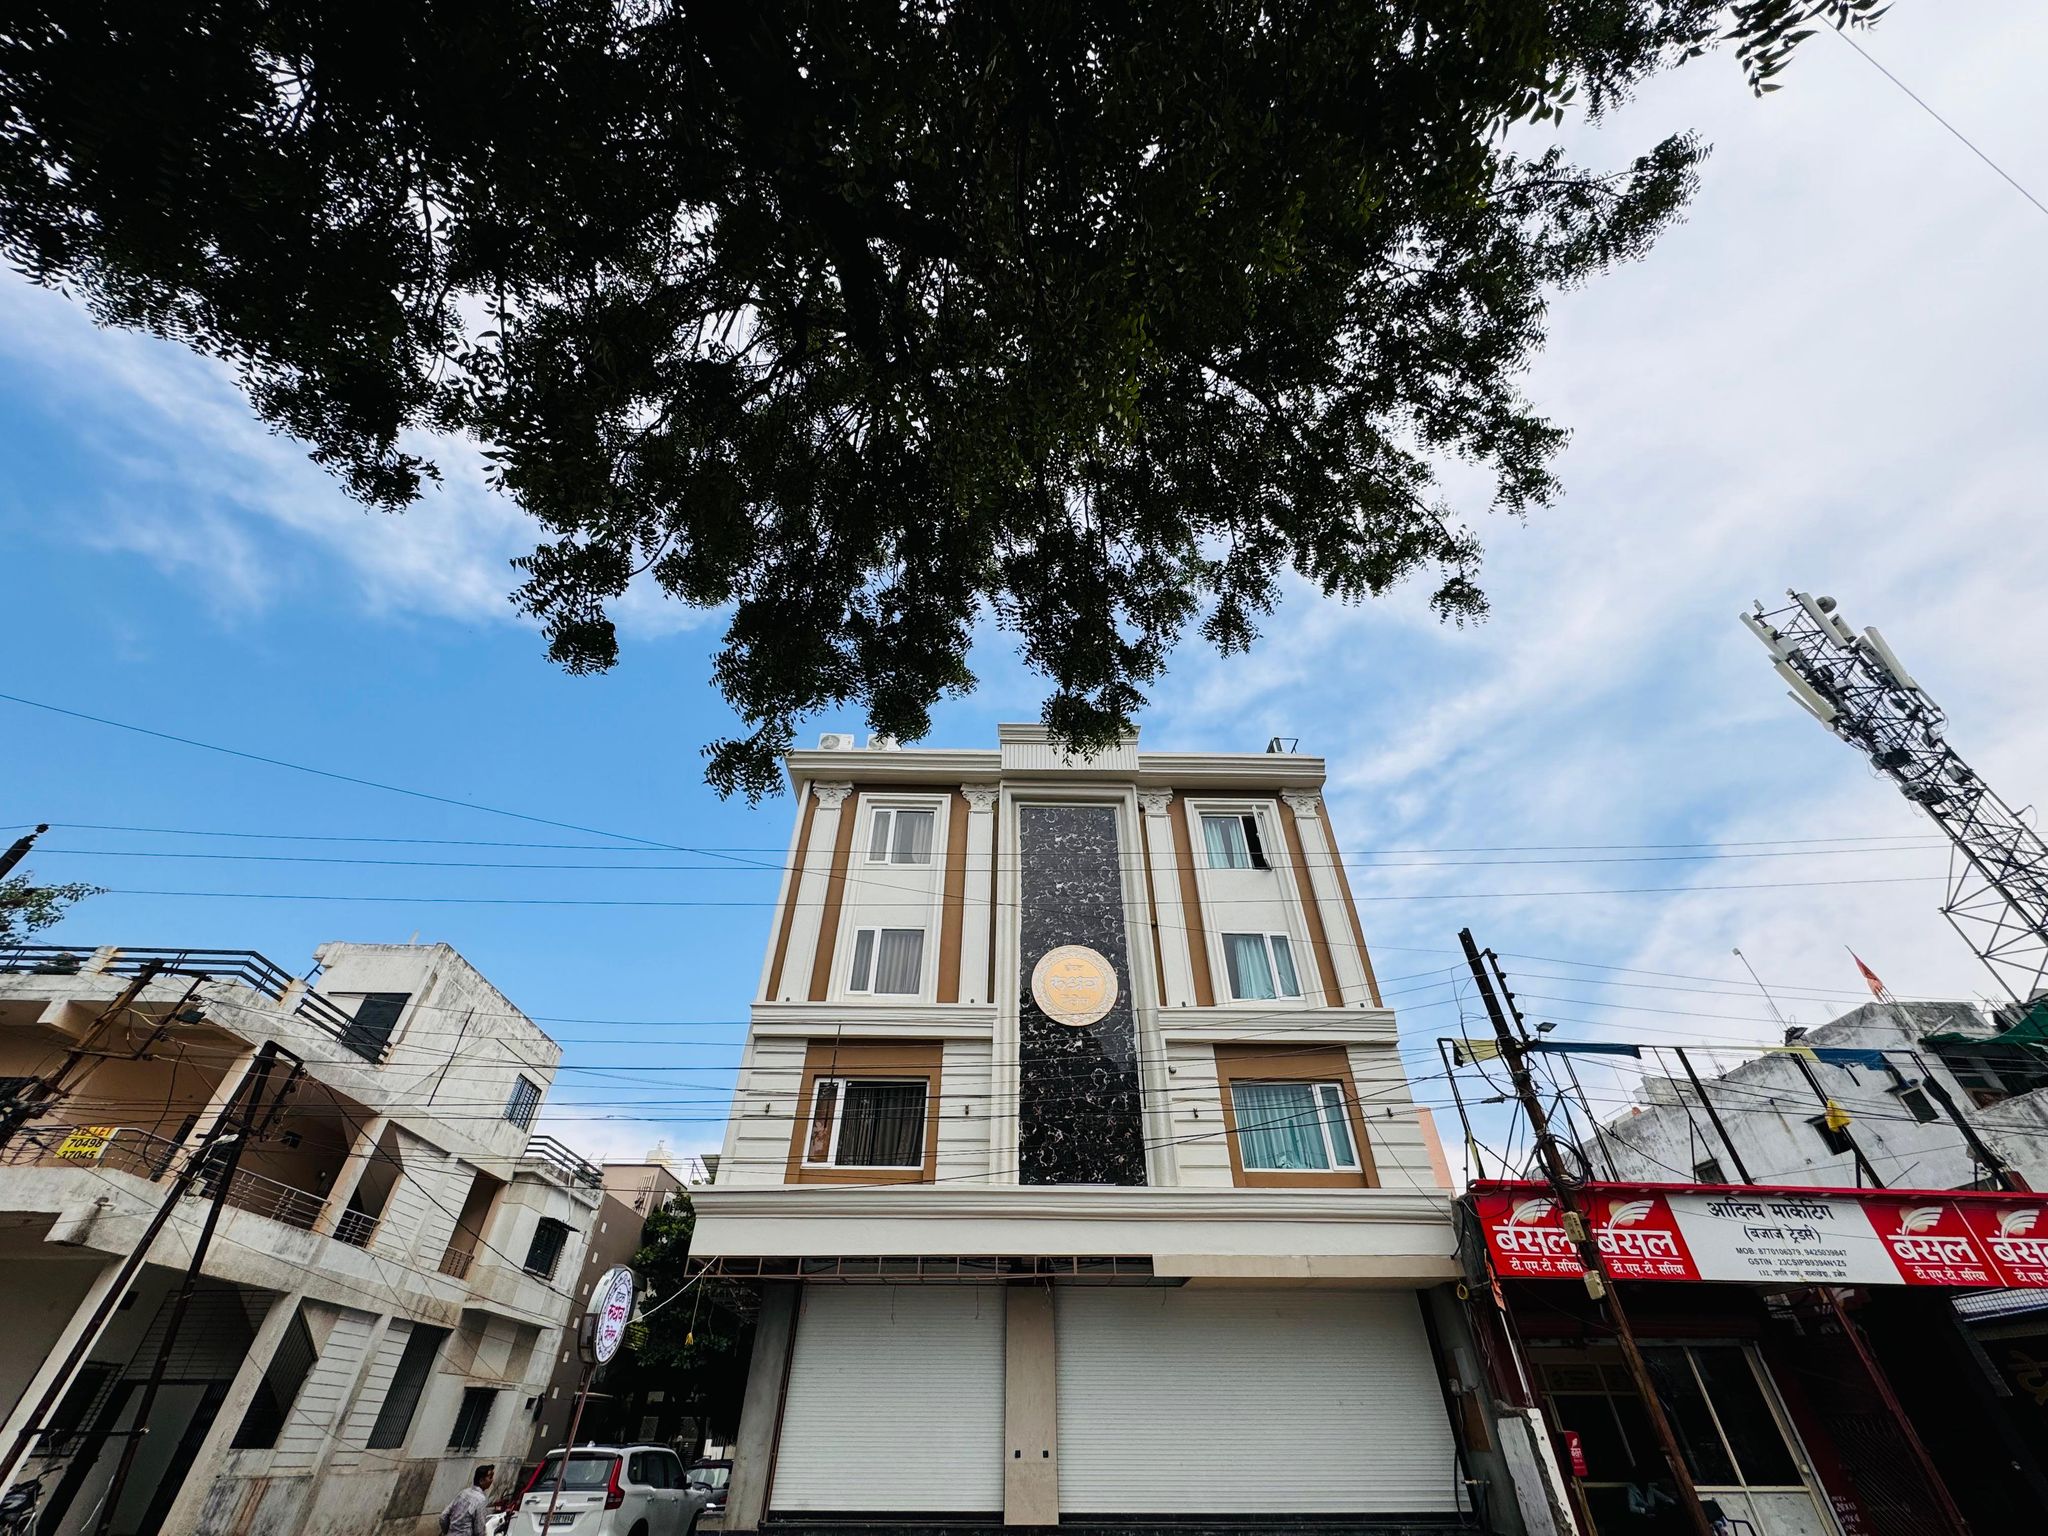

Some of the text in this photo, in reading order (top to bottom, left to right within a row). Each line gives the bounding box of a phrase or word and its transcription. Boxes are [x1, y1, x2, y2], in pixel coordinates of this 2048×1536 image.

[67, 1139, 104, 1148] 70498
[1707, 1197, 1766, 1220] आदित्य
[1492, 1219, 1578, 1257] बंसल
[1592, 1221, 1679, 1258] बंसल
[1743, 1224, 1822, 1243] (बजाज ट्रेडर्स)
[1887, 1228, 1979, 1265] बंसल
[1986, 1230, 2048, 1267] बंस
[1658, 1262, 1685, 1275] सरिया
[1748, 1258, 1772, 1266] GSTIN
[1959, 1268, 1989, 1282] सरिया
